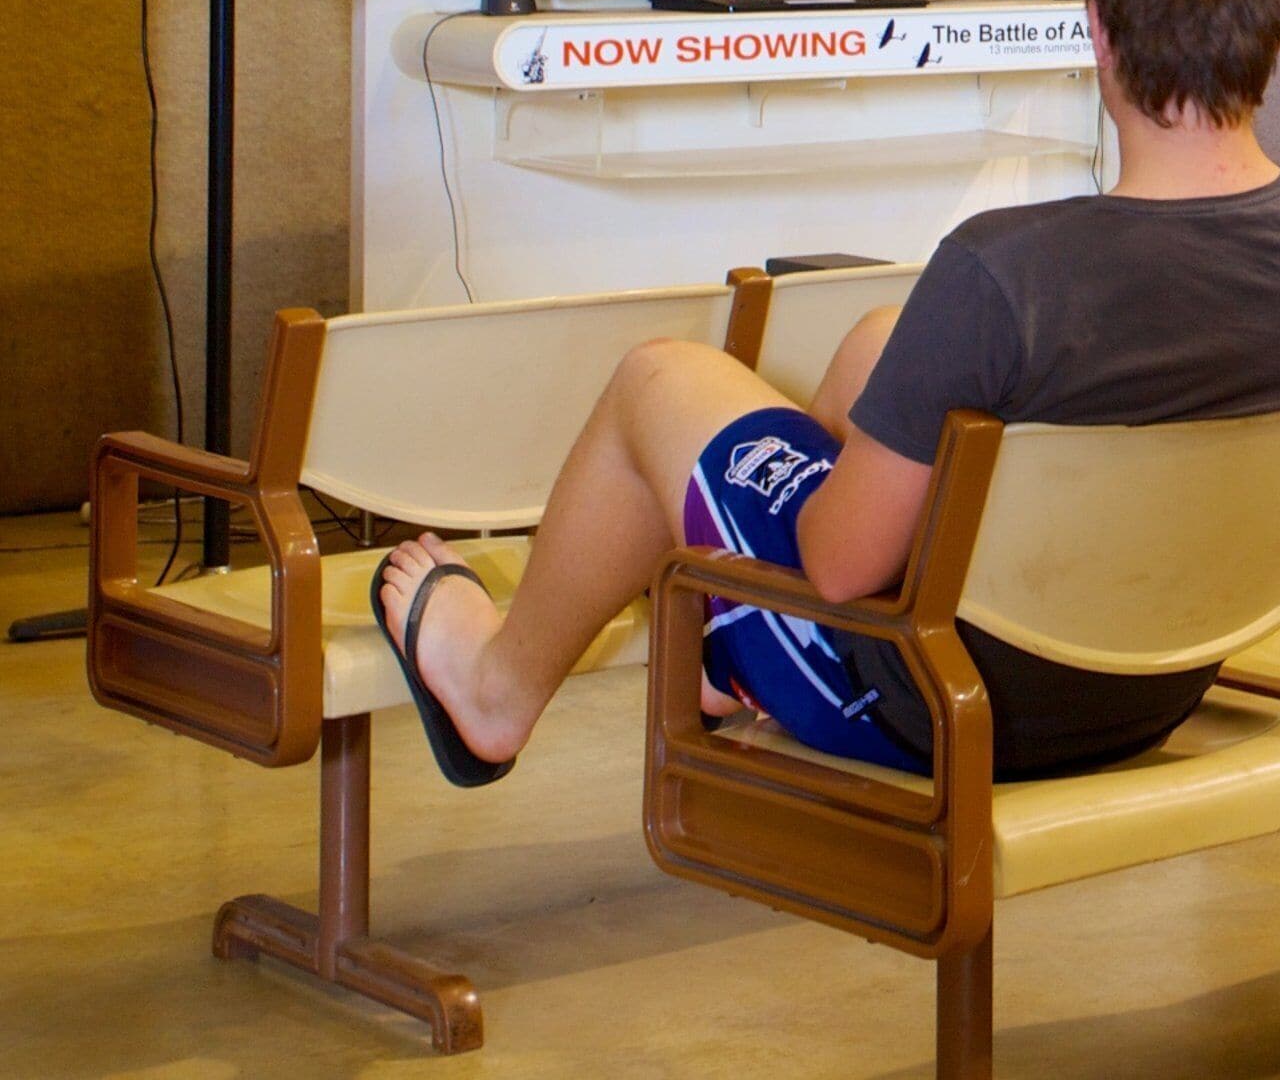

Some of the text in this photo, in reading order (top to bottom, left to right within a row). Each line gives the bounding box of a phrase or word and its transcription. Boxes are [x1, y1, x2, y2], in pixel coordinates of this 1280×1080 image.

[932, 25, 971, 43] The
[979, 23, 1038, 42] Battle
[1045, 21, 1065, 40] of
[563, 30, 866, 66] NOW SHOWING
[990, 45, 1001, 54] 13
[1003, 44, 1041, 54] minutes
[1044, 44, 1080, 54] running
